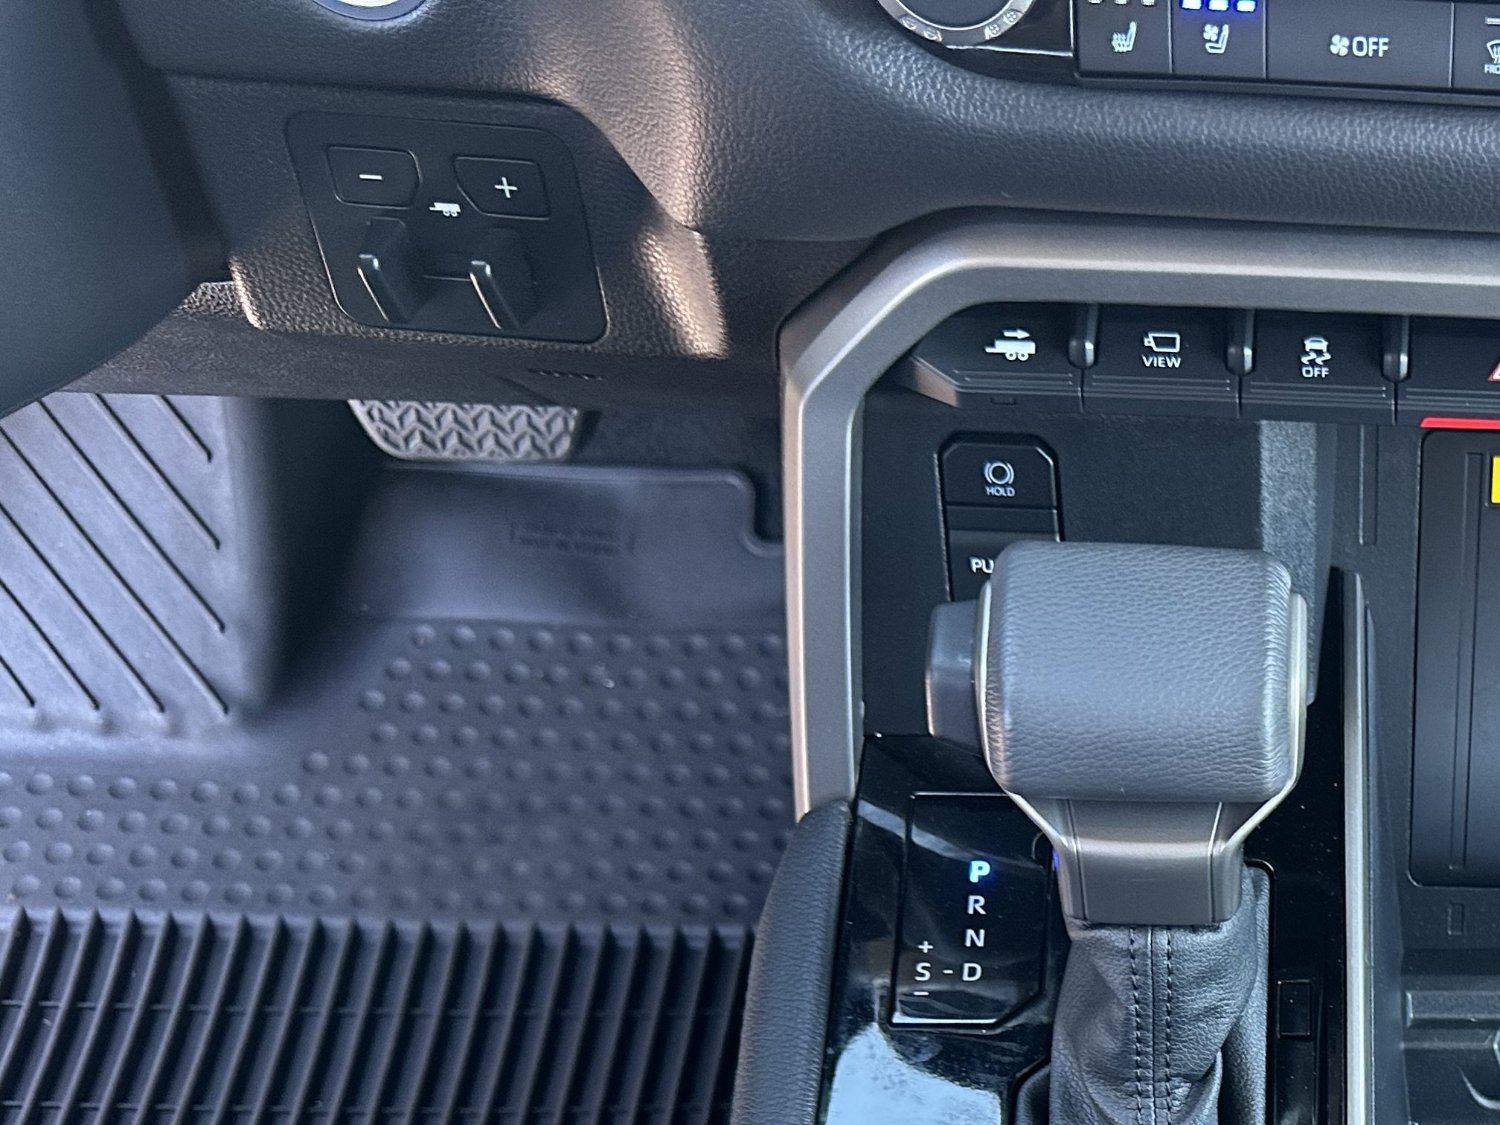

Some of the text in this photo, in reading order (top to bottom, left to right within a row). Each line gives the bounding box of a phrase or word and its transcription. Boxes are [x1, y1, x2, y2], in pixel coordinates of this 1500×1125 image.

[1352, 36, 1390, 58] OFF
[1141, 355, 1182, 369] VIEW
[1301, 366, 1330, 379] OFF
[985, 485, 1016, 498] HOLD
[969, 556, 994, 574] PU
[968, 860, 991, 883] P
[966, 895, 987, 915] R
[964, 928, 985, 947] N
[914, 962, 931, 982] S
[961, 962, 982, 982] D
